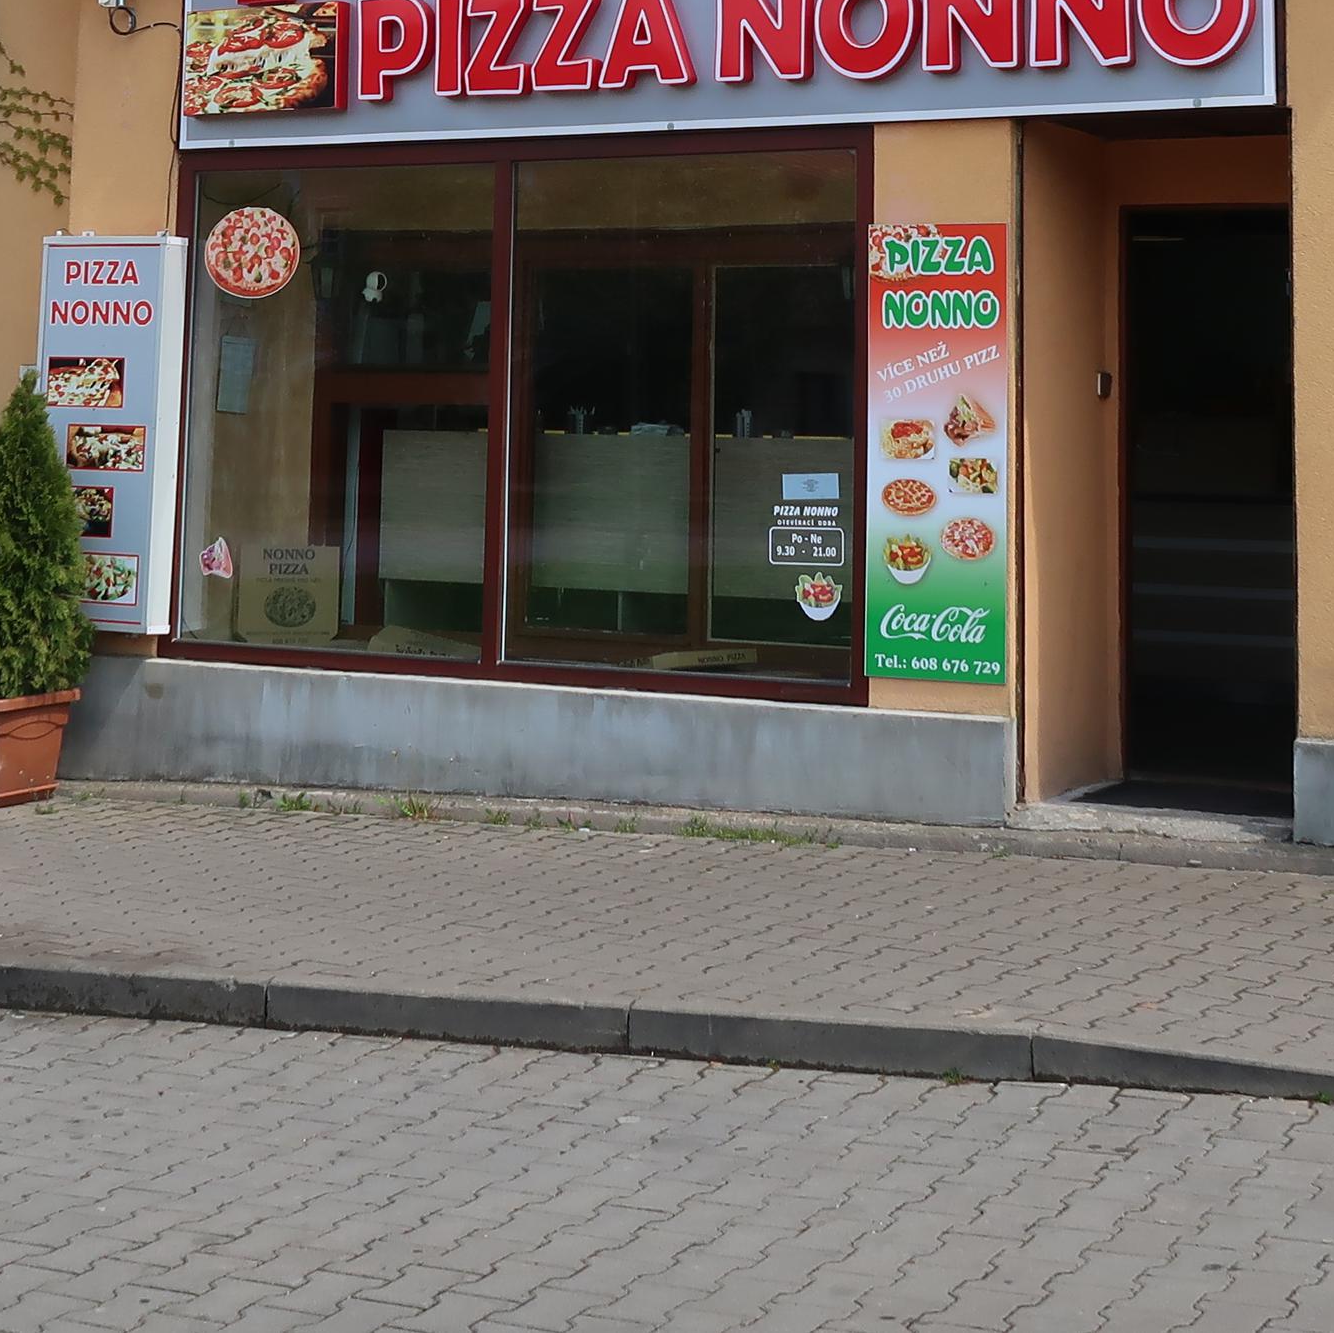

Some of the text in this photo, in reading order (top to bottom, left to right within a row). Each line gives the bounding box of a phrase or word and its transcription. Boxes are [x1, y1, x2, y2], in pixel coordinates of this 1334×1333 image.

[883, 235, 995, 276] PIZZA
[64, 259, 140, 286] PIZZA
[50, 299, 155, 327] NONNO
[882, 289, 1000, 329] NONNO
[876, 340, 950, 383] VÍCE NEŽ
[883, 386, 902, 404] 30
[962, 344, 1001, 370] PIZZ
[773, 505, 839, 517] PIZZA NONNO
[776, 545, 796, 556] 9.30
[812, 546, 837, 557] 21.00
[791, 533, 803, 544] Po
[810, 533, 823, 544] Ne
[262, 548, 316, 561] NONNO
[268, 563, 309, 576] PIZZA
[880, 603, 991, 644] Coca-Cola
[874, 653, 1001, 676] Tel.: 608 676 729
